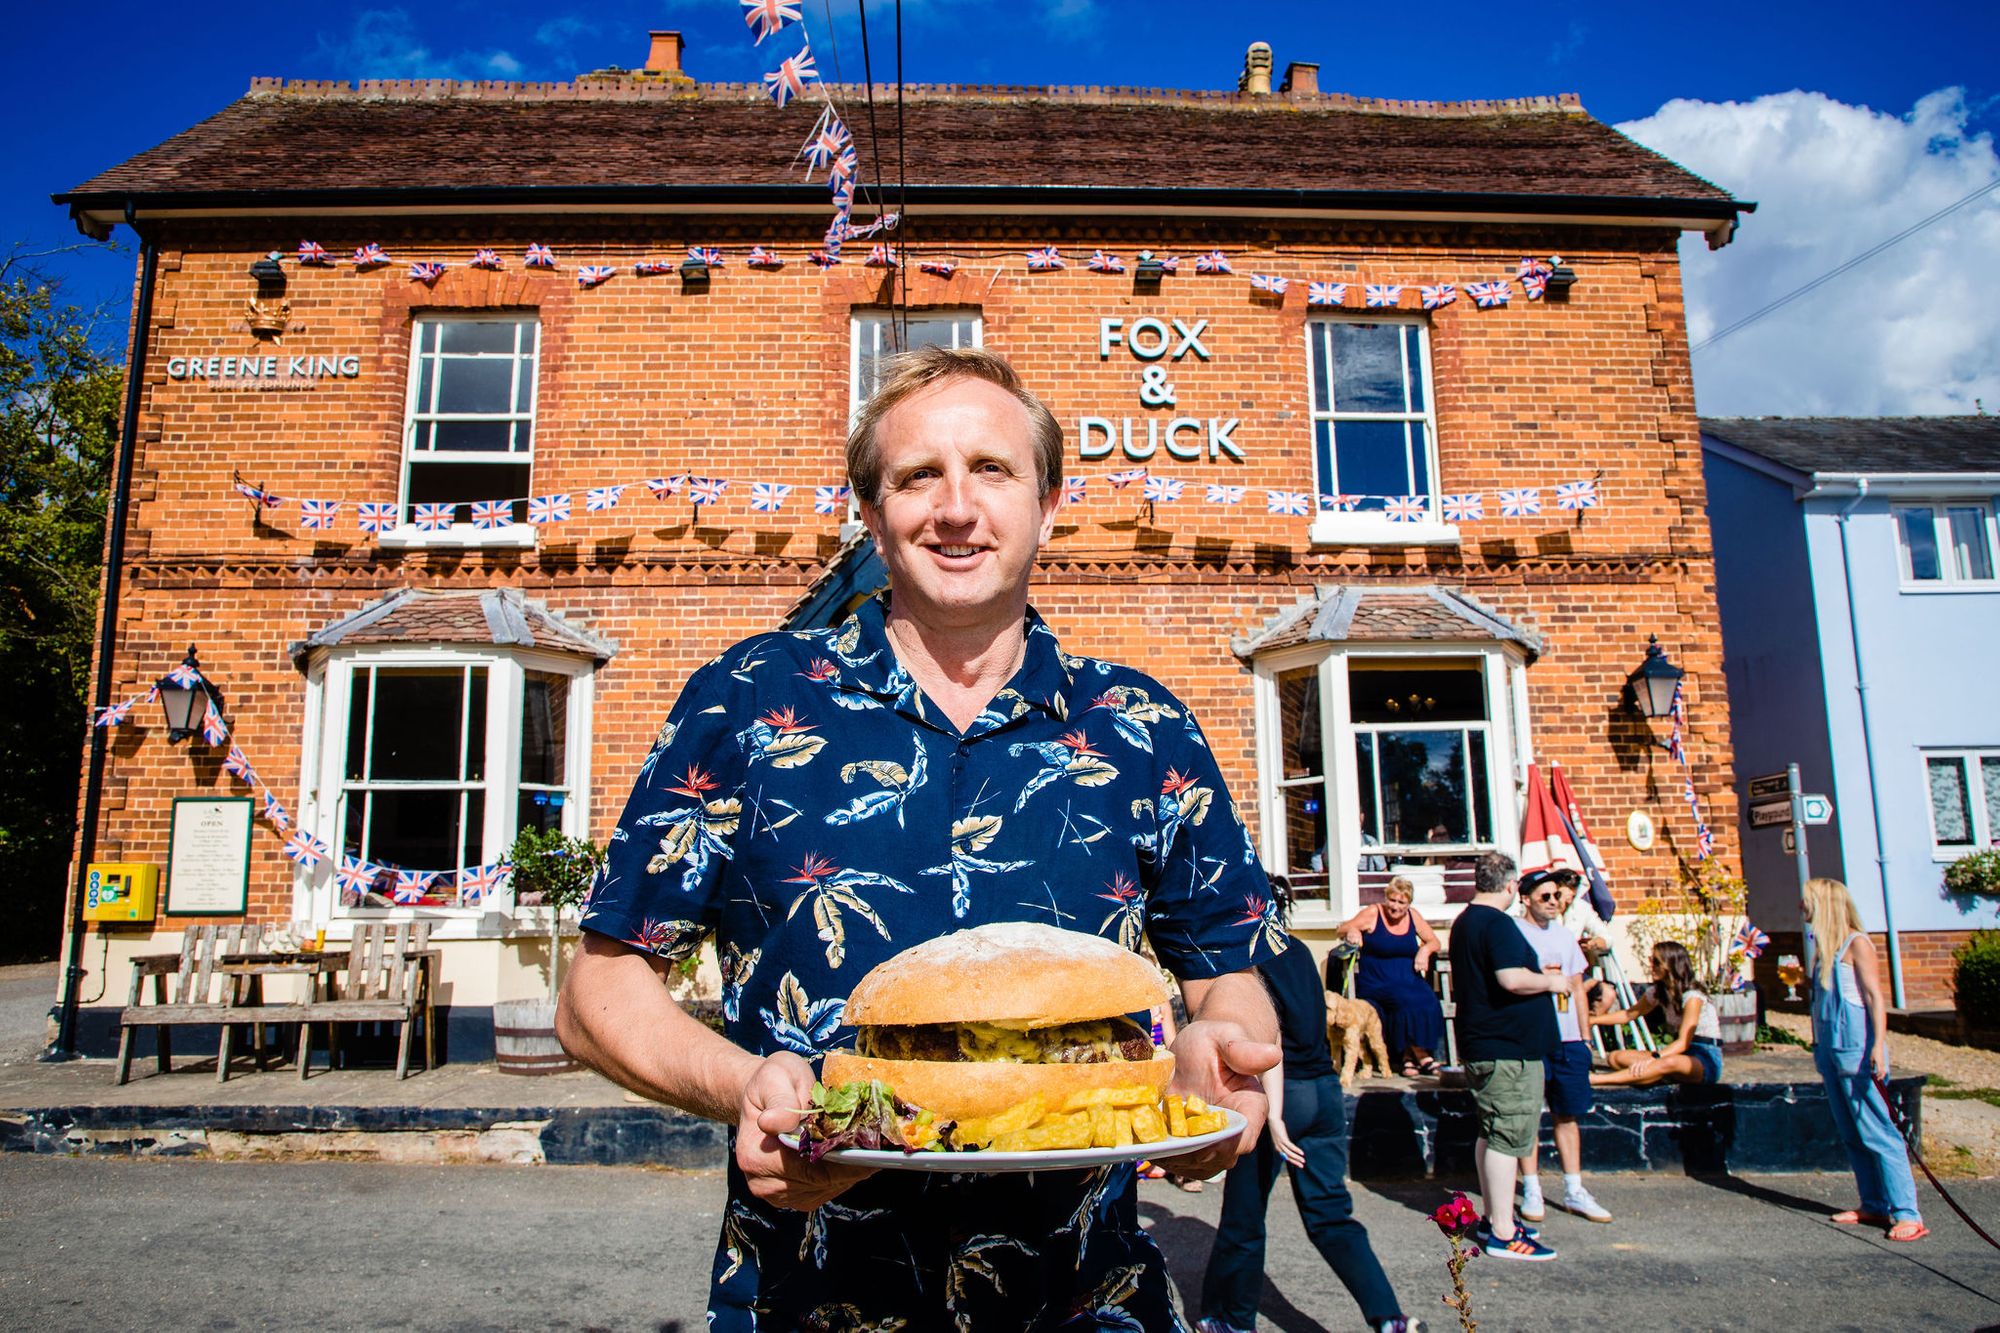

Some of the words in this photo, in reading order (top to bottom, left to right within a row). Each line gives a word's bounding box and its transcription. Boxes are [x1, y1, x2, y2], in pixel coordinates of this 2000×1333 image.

[1100, 317, 1212, 358] FOX
[167, 356, 278, 378] GREENE
[288, 355, 360, 377] KING
[208, 379, 237, 388] BURY
[259, 379, 315, 388] EDMUNDS
[1139, 365, 1178, 405] &
[1079, 416, 1247, 458] DUCK
